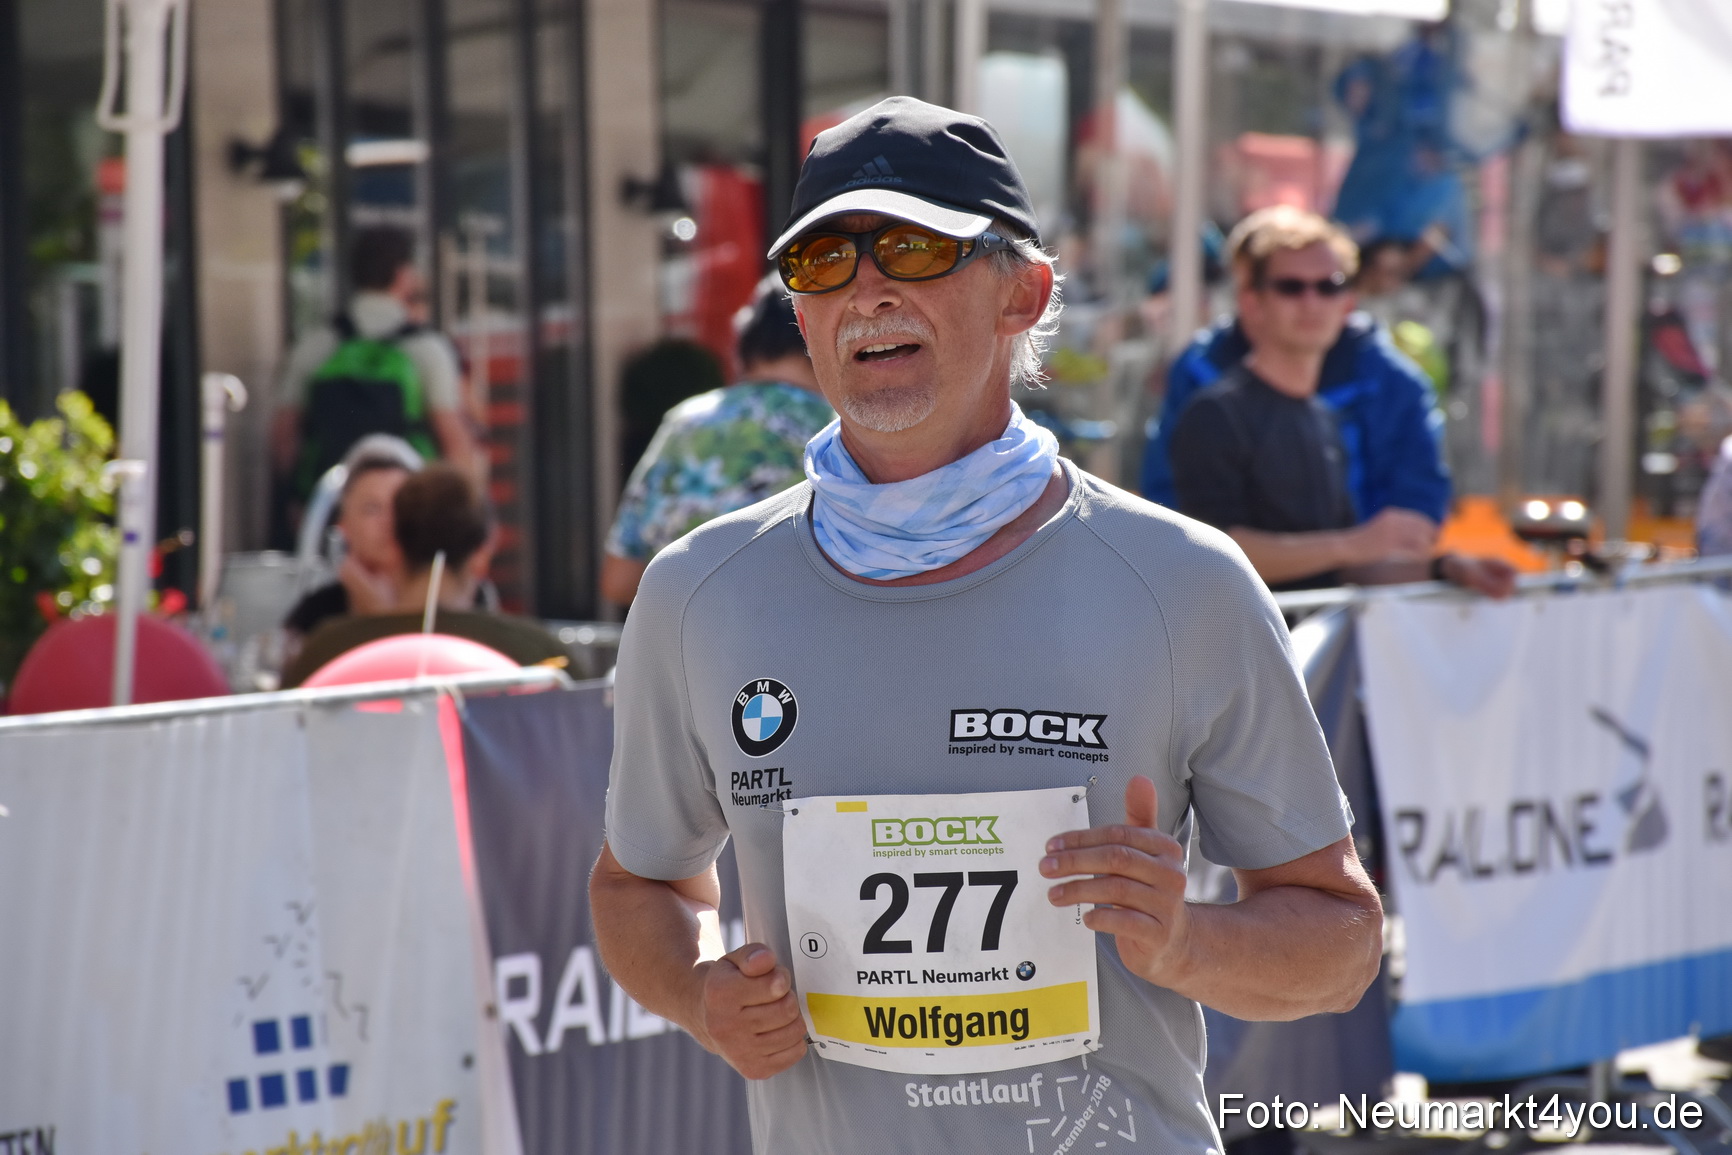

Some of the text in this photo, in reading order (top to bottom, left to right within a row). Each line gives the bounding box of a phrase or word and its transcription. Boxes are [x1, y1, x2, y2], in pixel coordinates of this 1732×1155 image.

[845, 174, 903, 187] adidas
[736, 680, 793, 707] BMW
[951, 709, 1106, 748] BOCK
[948, 744, 1109, 764] inspired by smart concepts
[731, 767, 792, 790] PARTL
[731, 788, 792, 806] Neumarkt
[872, 816, 1002, 847] BOCK
[873, 846, 1004, 858] inspired by smart concepts
[859, 870, 1018, 954] 277
[808, 938, 819, 953] D
[857, 967, 1009, 985] PARTL Neumarkt
[863, 1005, 1030, 1046] Wolfgang
[905, 1073, 1043, 1108] Stadtlauf
[1090, 1075, 1112, 1108] 2018
